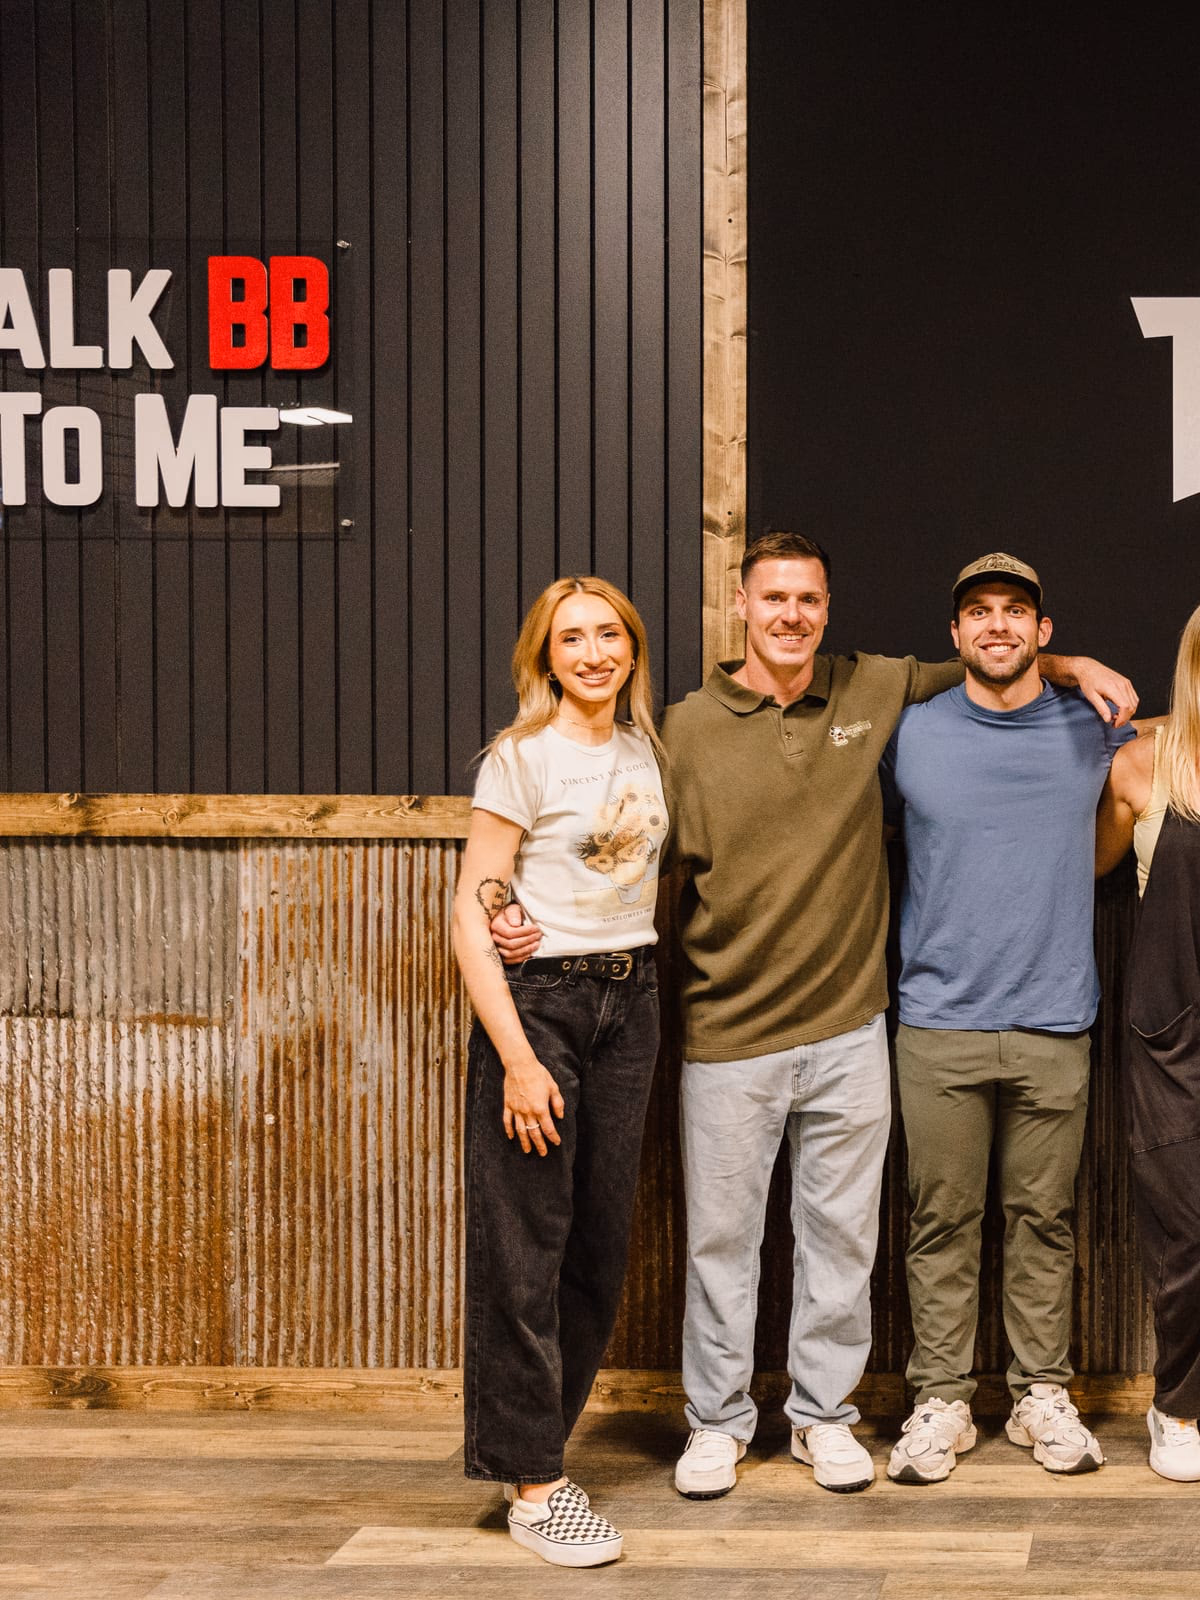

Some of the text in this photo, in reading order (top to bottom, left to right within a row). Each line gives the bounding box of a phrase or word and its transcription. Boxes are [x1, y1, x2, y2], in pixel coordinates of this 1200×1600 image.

[208, 256, 330, 370] BB
[0, 392, 281, 508] TO ME
[560, 773, 605, 786] VINCENT
